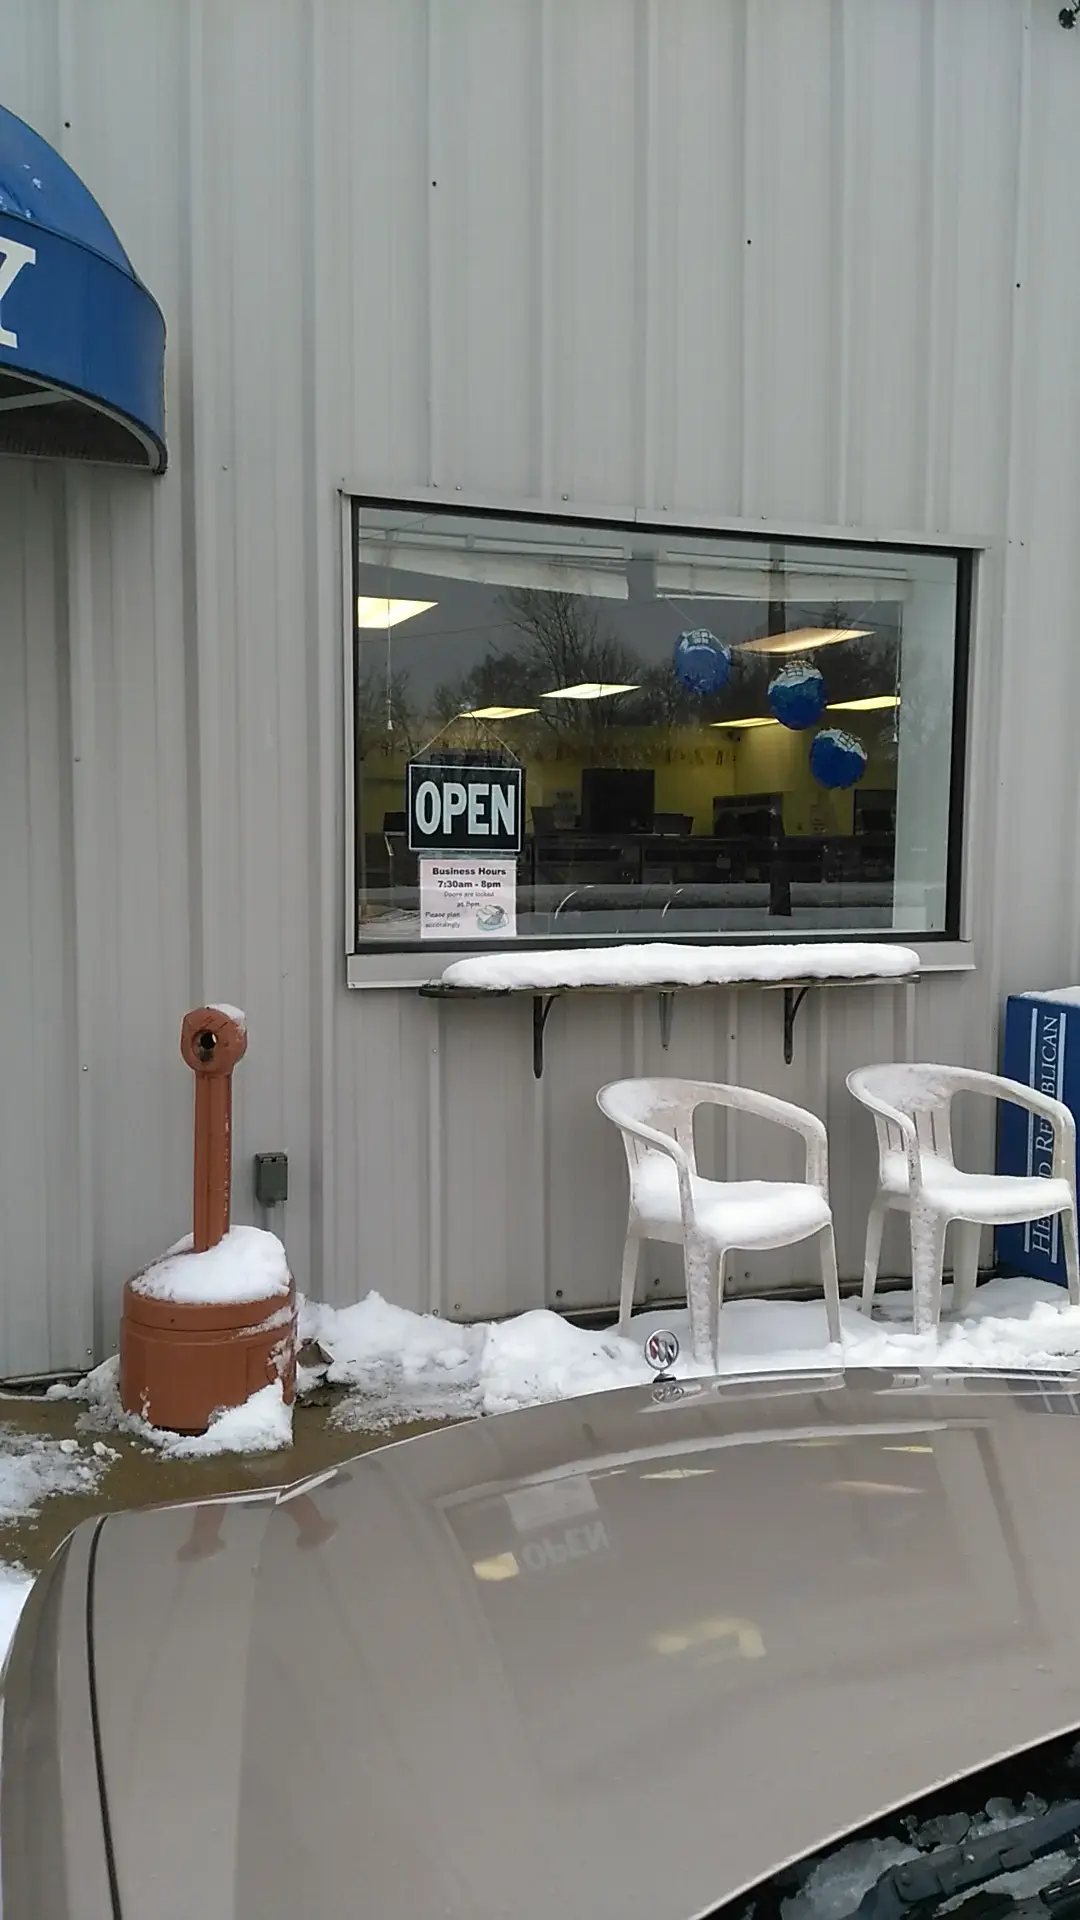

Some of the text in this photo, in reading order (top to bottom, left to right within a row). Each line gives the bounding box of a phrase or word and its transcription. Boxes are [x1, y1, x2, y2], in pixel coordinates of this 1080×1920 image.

[415, 780, 515, 836] OPEN
[432, 867, 507, 876] Business Hours
[437, 880, 473, 888] 7:30am
[480, 880, 501, 889] 8pm
[425, 921, 461, 929] accordingly
[1036, 1016, 1059, 1153] REBLICAN
